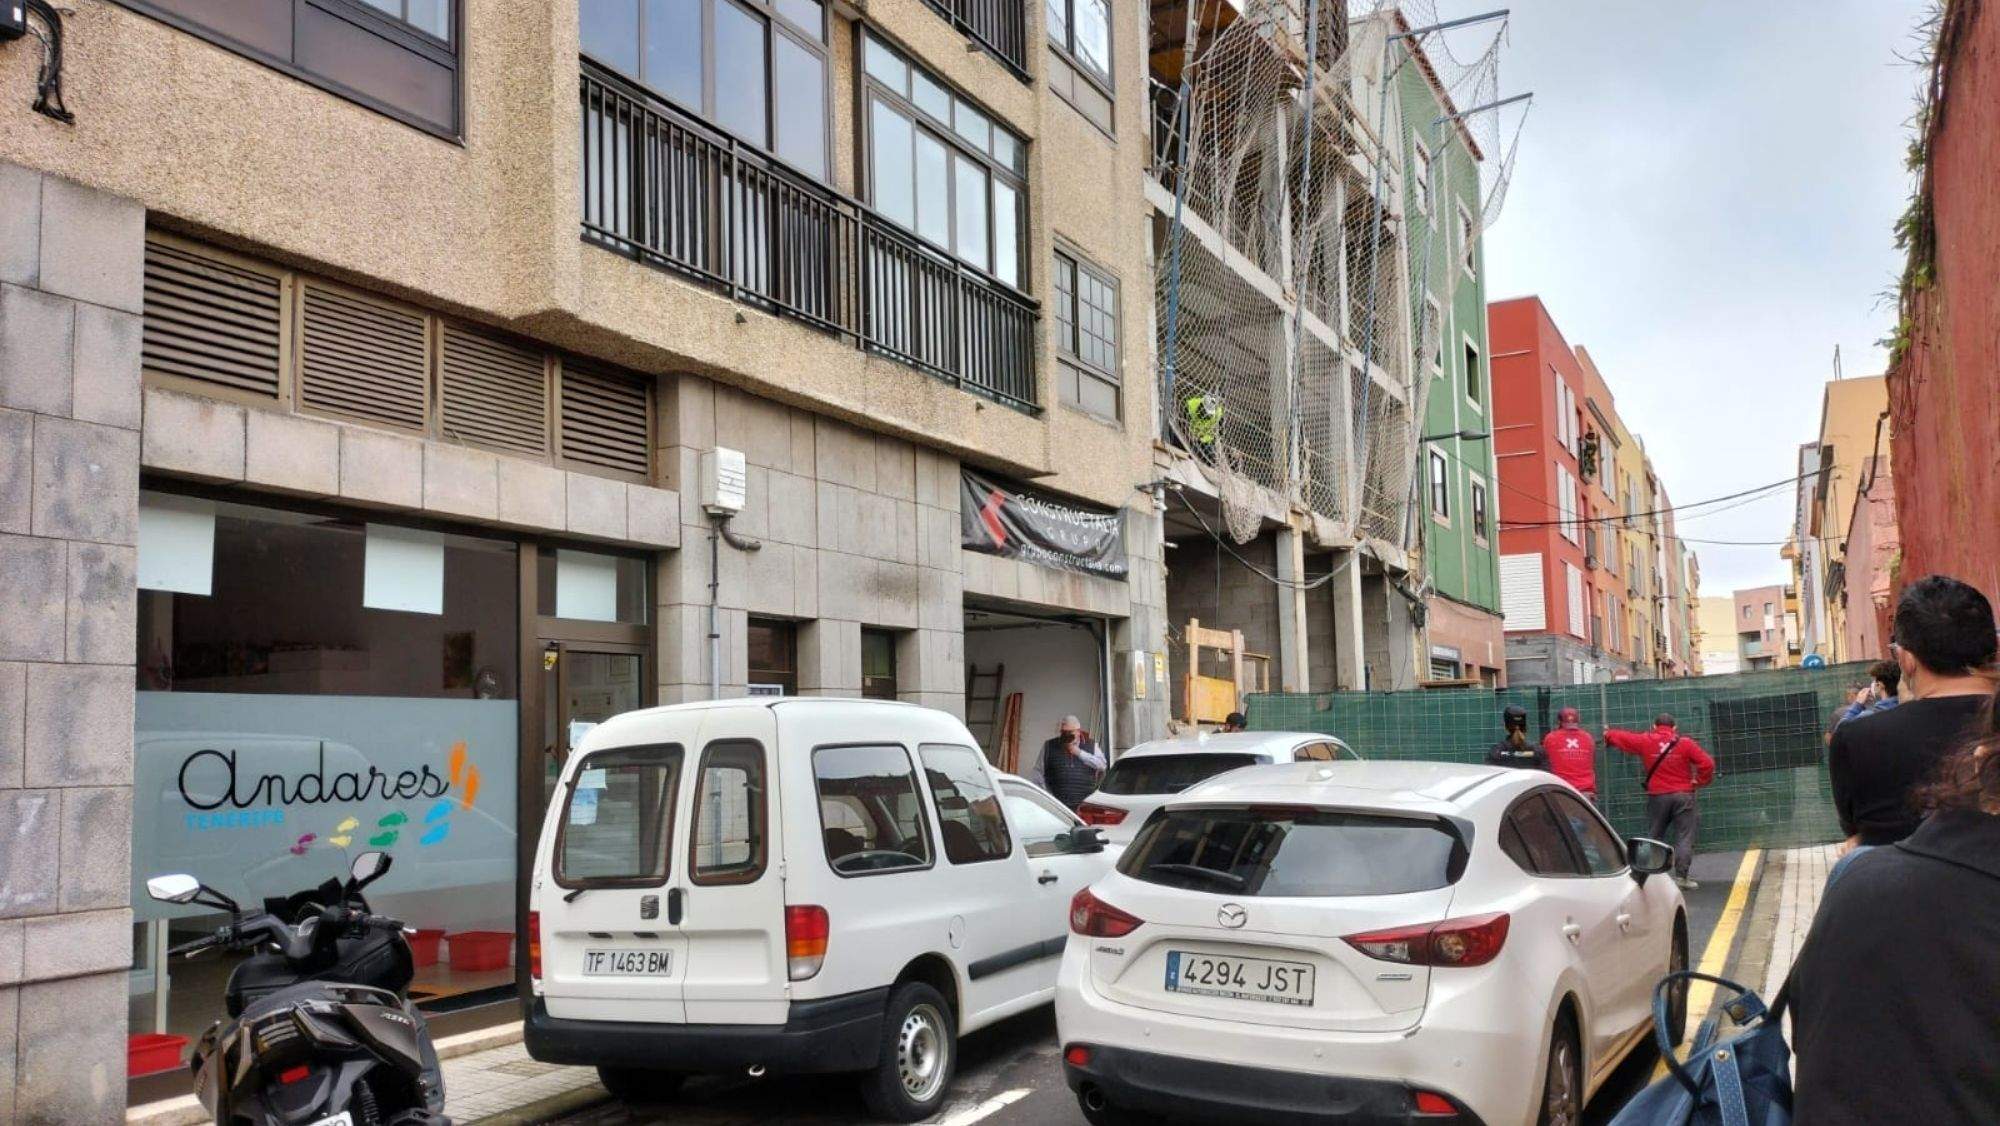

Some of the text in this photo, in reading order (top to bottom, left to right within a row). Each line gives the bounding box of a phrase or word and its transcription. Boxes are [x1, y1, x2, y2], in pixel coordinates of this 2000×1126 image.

[588, 952, 670, 973] TF 1463 BM
[1184, 958, 1307, 994] 4294 JST
